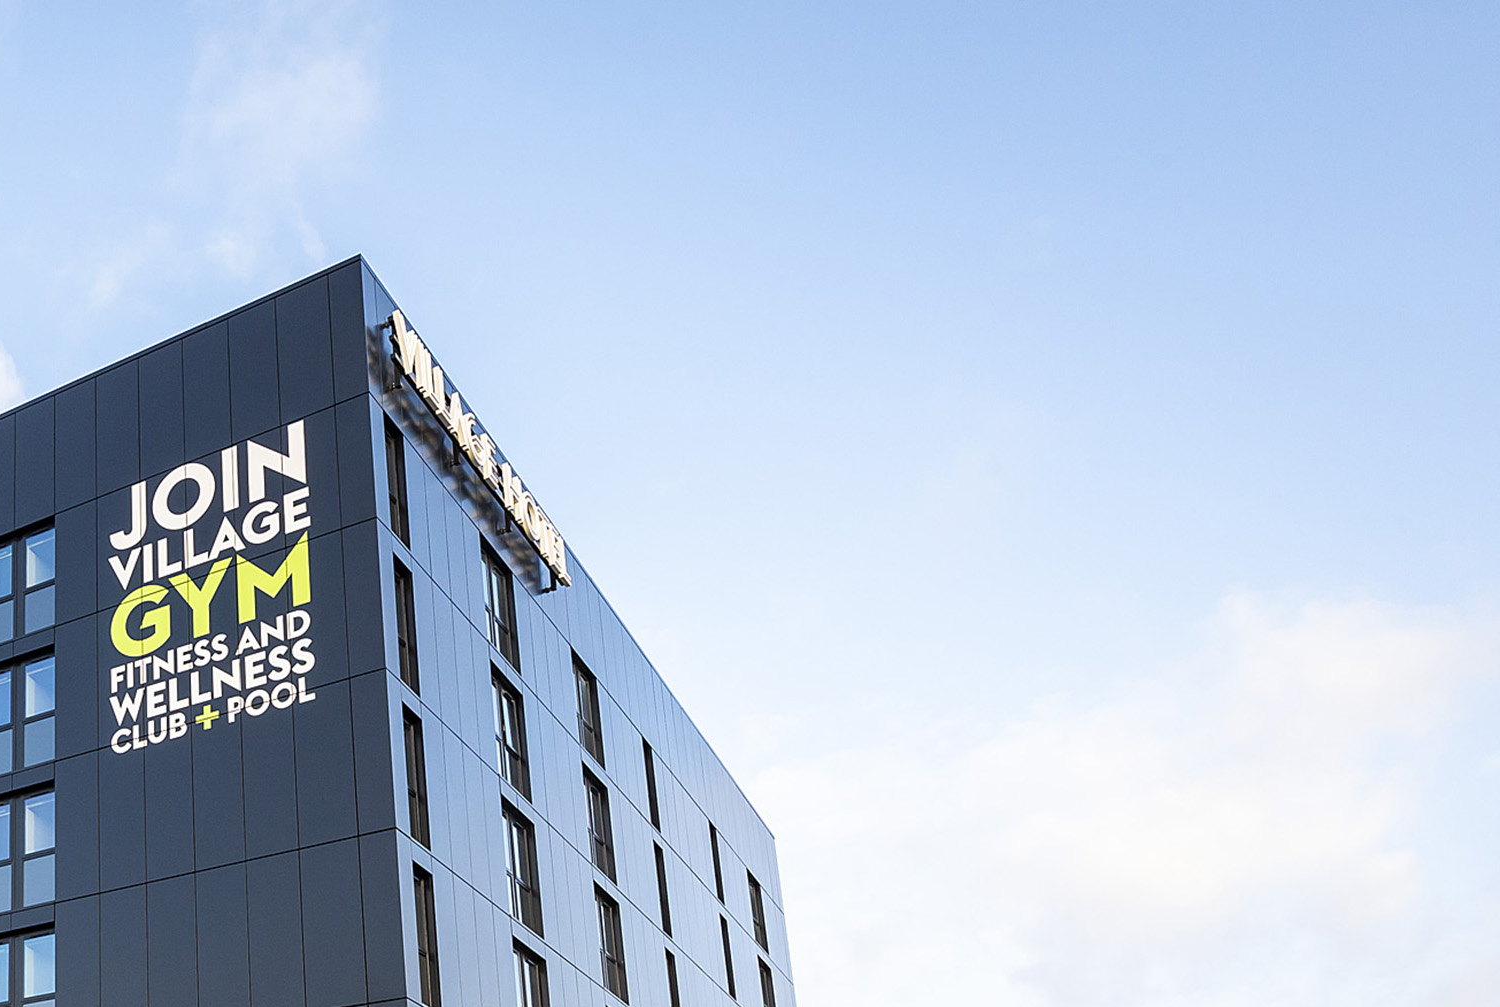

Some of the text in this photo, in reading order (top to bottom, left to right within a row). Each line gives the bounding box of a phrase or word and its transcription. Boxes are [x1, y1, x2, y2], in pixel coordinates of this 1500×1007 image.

[109, 419, 307, 551] JOIN
[392, 309, 572, 588] VILLAGE HOTEL
[108, 486, 311, 590] VILLAGE
[110, 530, 311, 657] GYM
[109, 638, 316, 726] WELLNESS
[110, 609, 311, 694] FITNESS AND
[110, 712, 188, 754] CLUB
[227, 677, 316, 723] POOL
